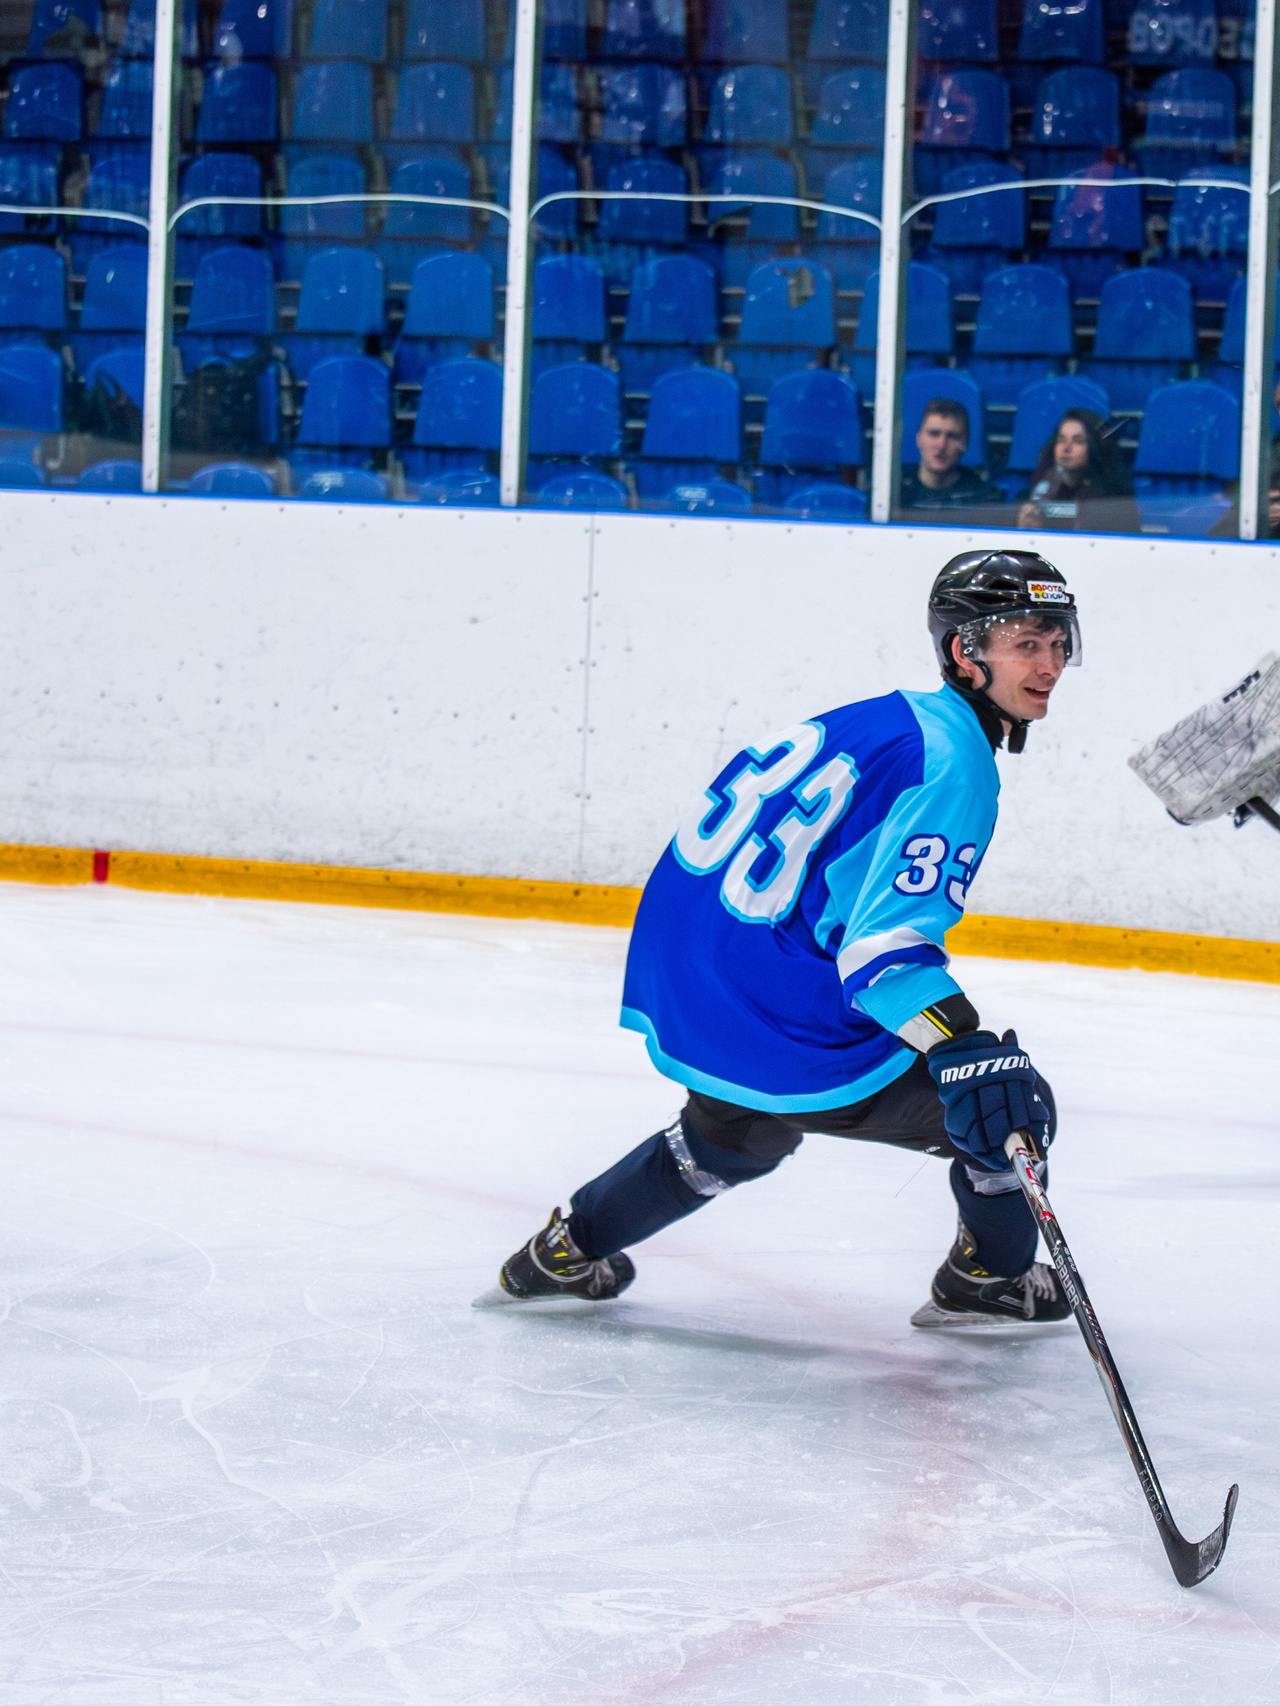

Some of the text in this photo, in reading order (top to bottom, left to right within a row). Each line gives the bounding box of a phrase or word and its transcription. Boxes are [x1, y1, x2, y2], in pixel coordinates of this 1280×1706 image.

[673, 720, 860, 926] 33
[941, 1056, 1030, 1084] MOTION
[1139, 1468, 1163, 1522] FLYPRO
